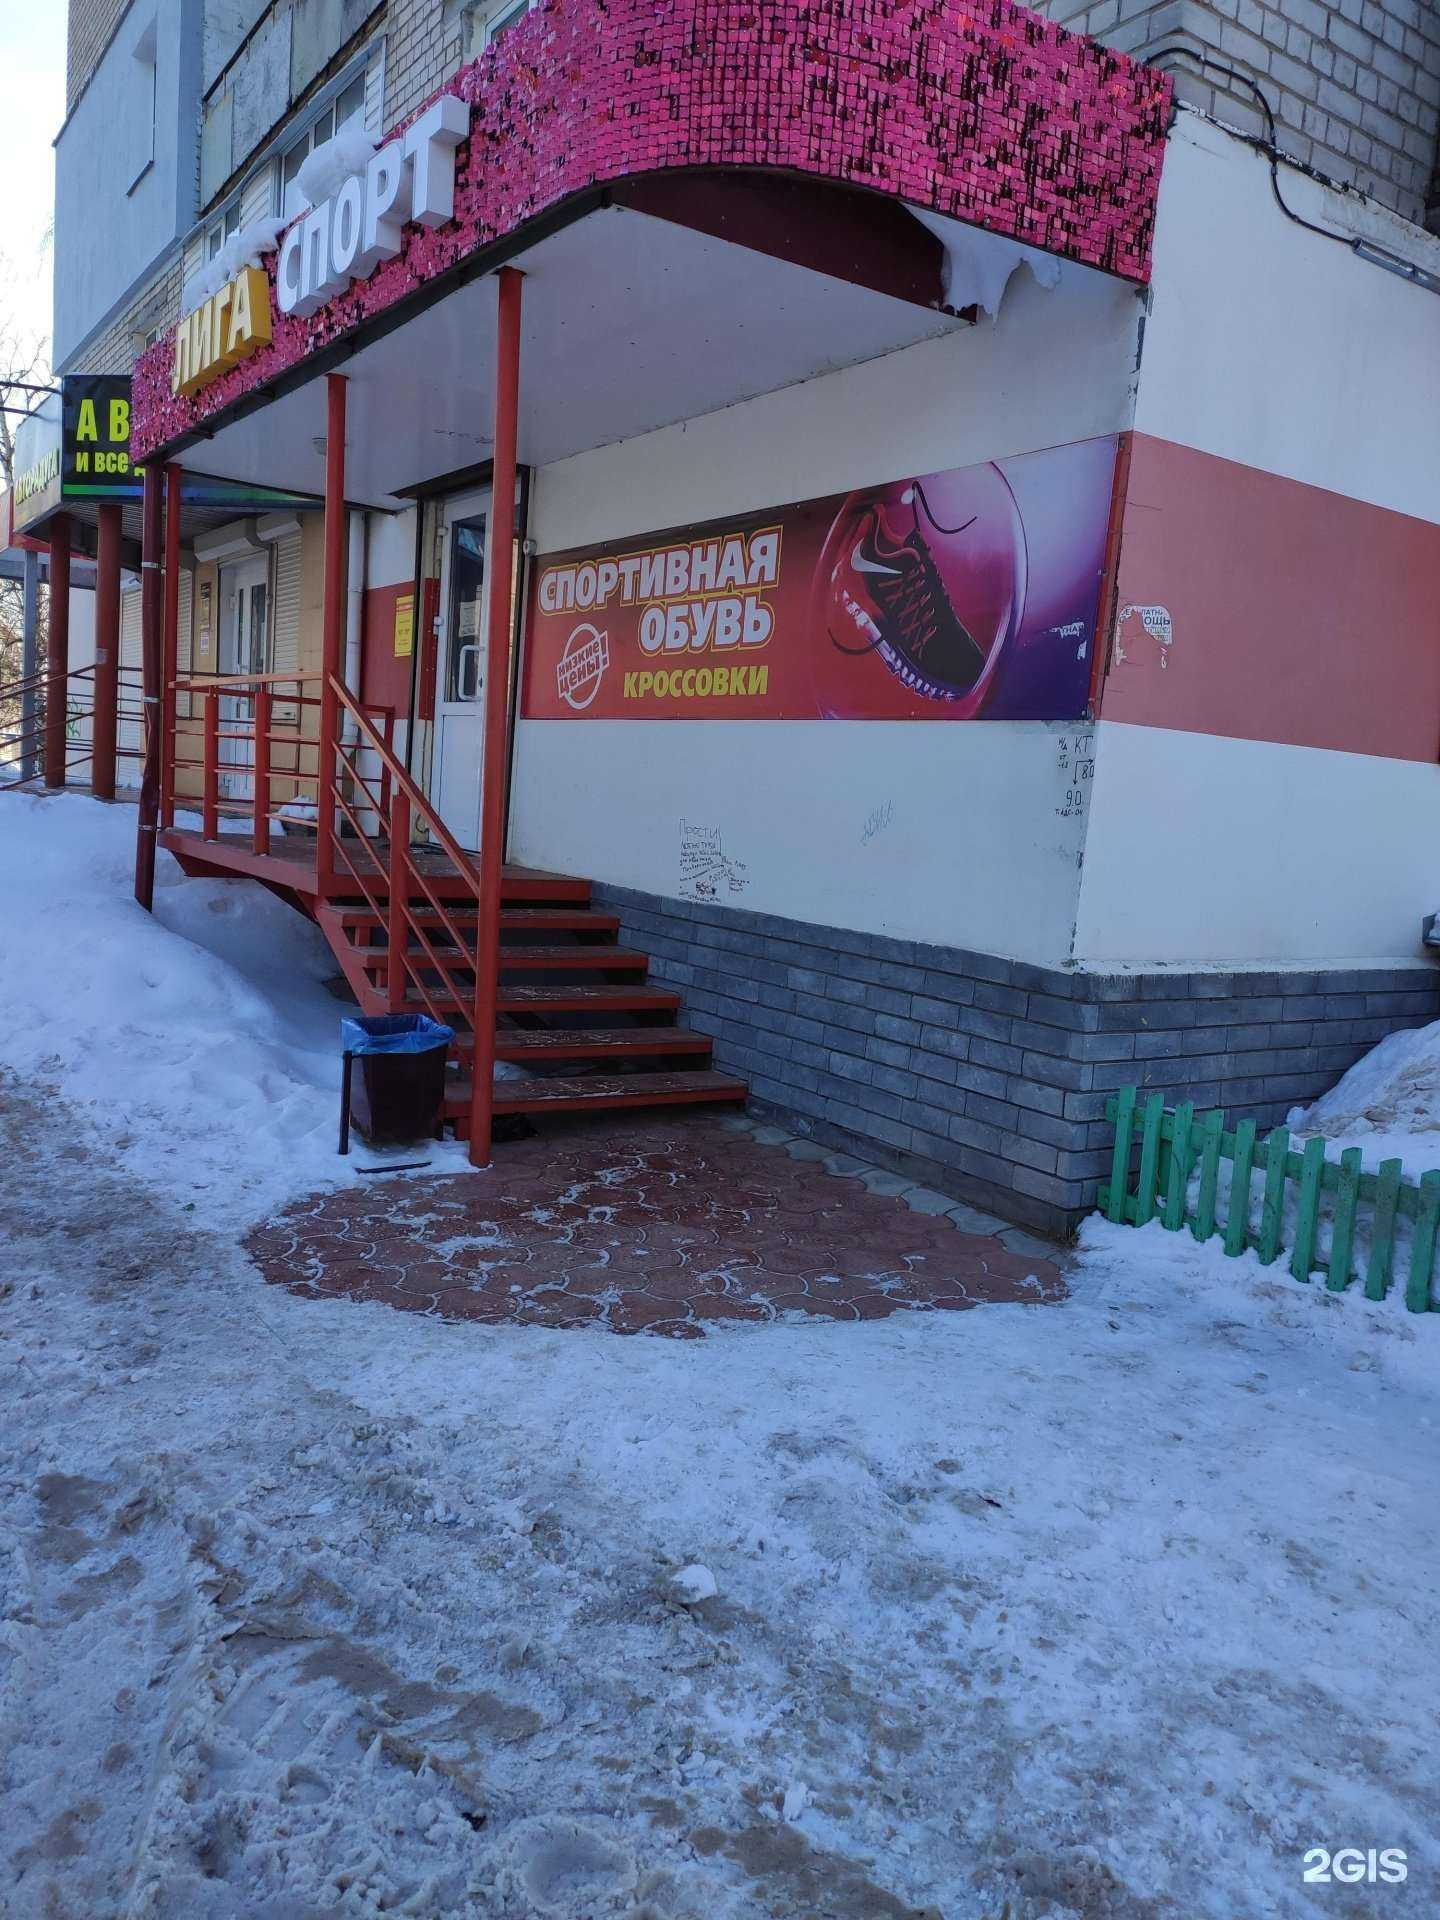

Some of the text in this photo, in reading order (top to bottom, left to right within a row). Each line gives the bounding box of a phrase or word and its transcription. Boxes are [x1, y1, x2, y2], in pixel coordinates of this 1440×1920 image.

[171, 95, 469, 394] ЛИГА СПОРТ
[539, 531, 780, 612] СПОРТИВНАЯ
[641, 597, 771, 651] ОБУВЬ
[623, 666, 768, 698] КРОССОВКИ
